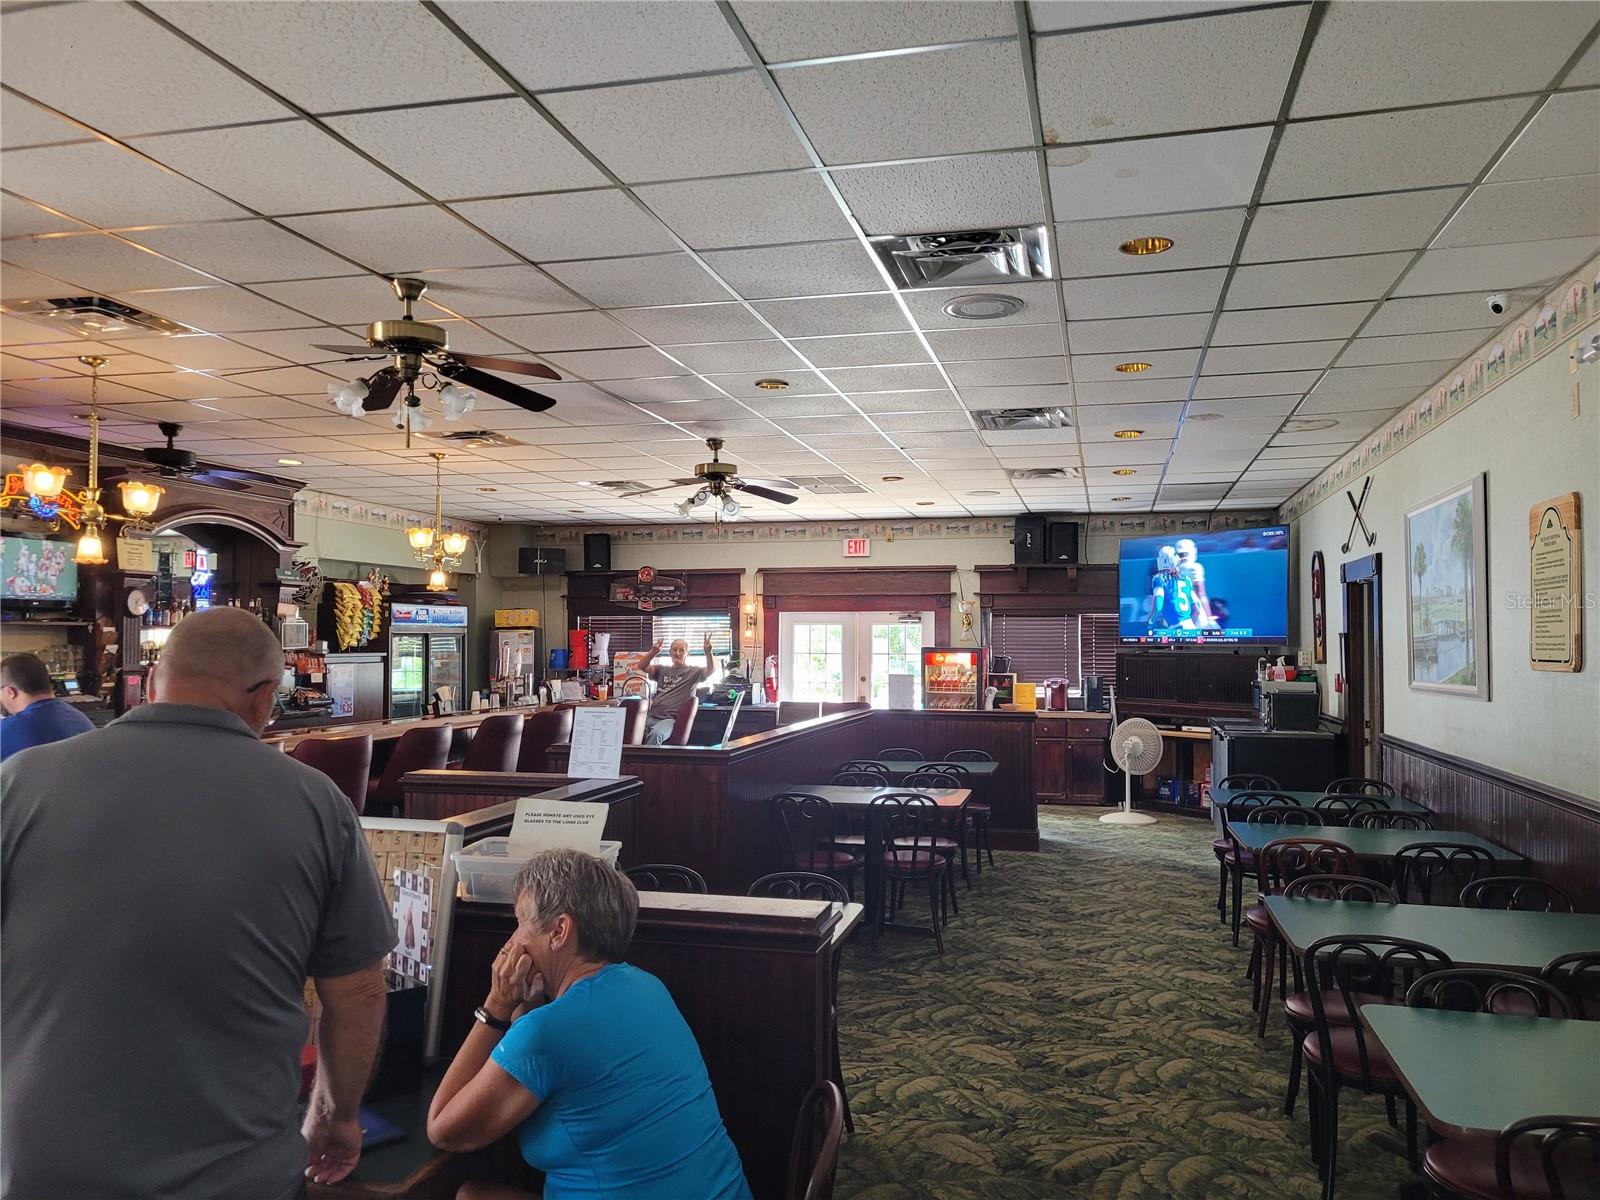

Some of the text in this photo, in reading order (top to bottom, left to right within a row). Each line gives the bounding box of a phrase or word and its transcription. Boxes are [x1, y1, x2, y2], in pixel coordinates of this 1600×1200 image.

[848, 539, 866, 554] EXIT
[1177, 580, 1189, 611] 5
[394, 836, 401, 846] 5
[413, 838, 419, 848] 6
[432, 838, 439, 849] 7
